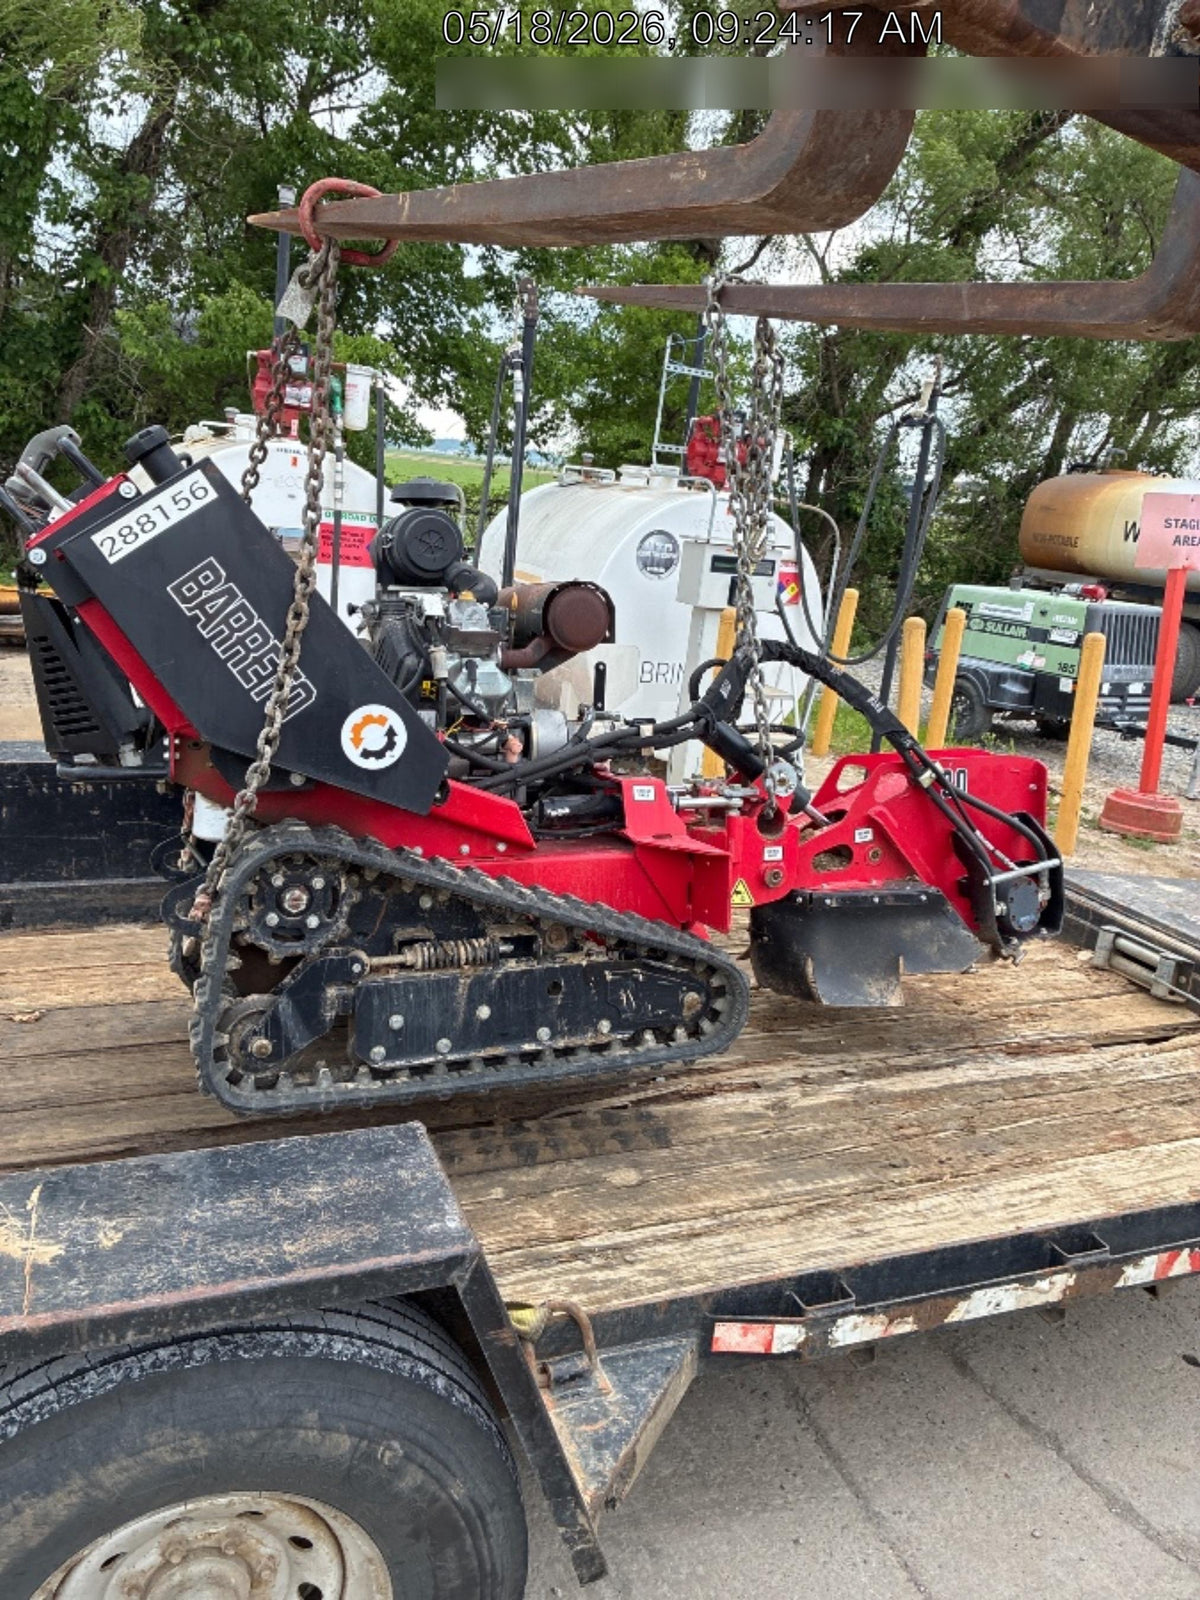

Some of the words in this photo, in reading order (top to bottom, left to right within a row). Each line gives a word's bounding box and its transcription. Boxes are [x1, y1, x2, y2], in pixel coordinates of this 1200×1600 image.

[100, 480, 209, 557] 288156
[985, 621, 1027, 638] SULLAIR
[1057, 662, 1076, 674] 185
